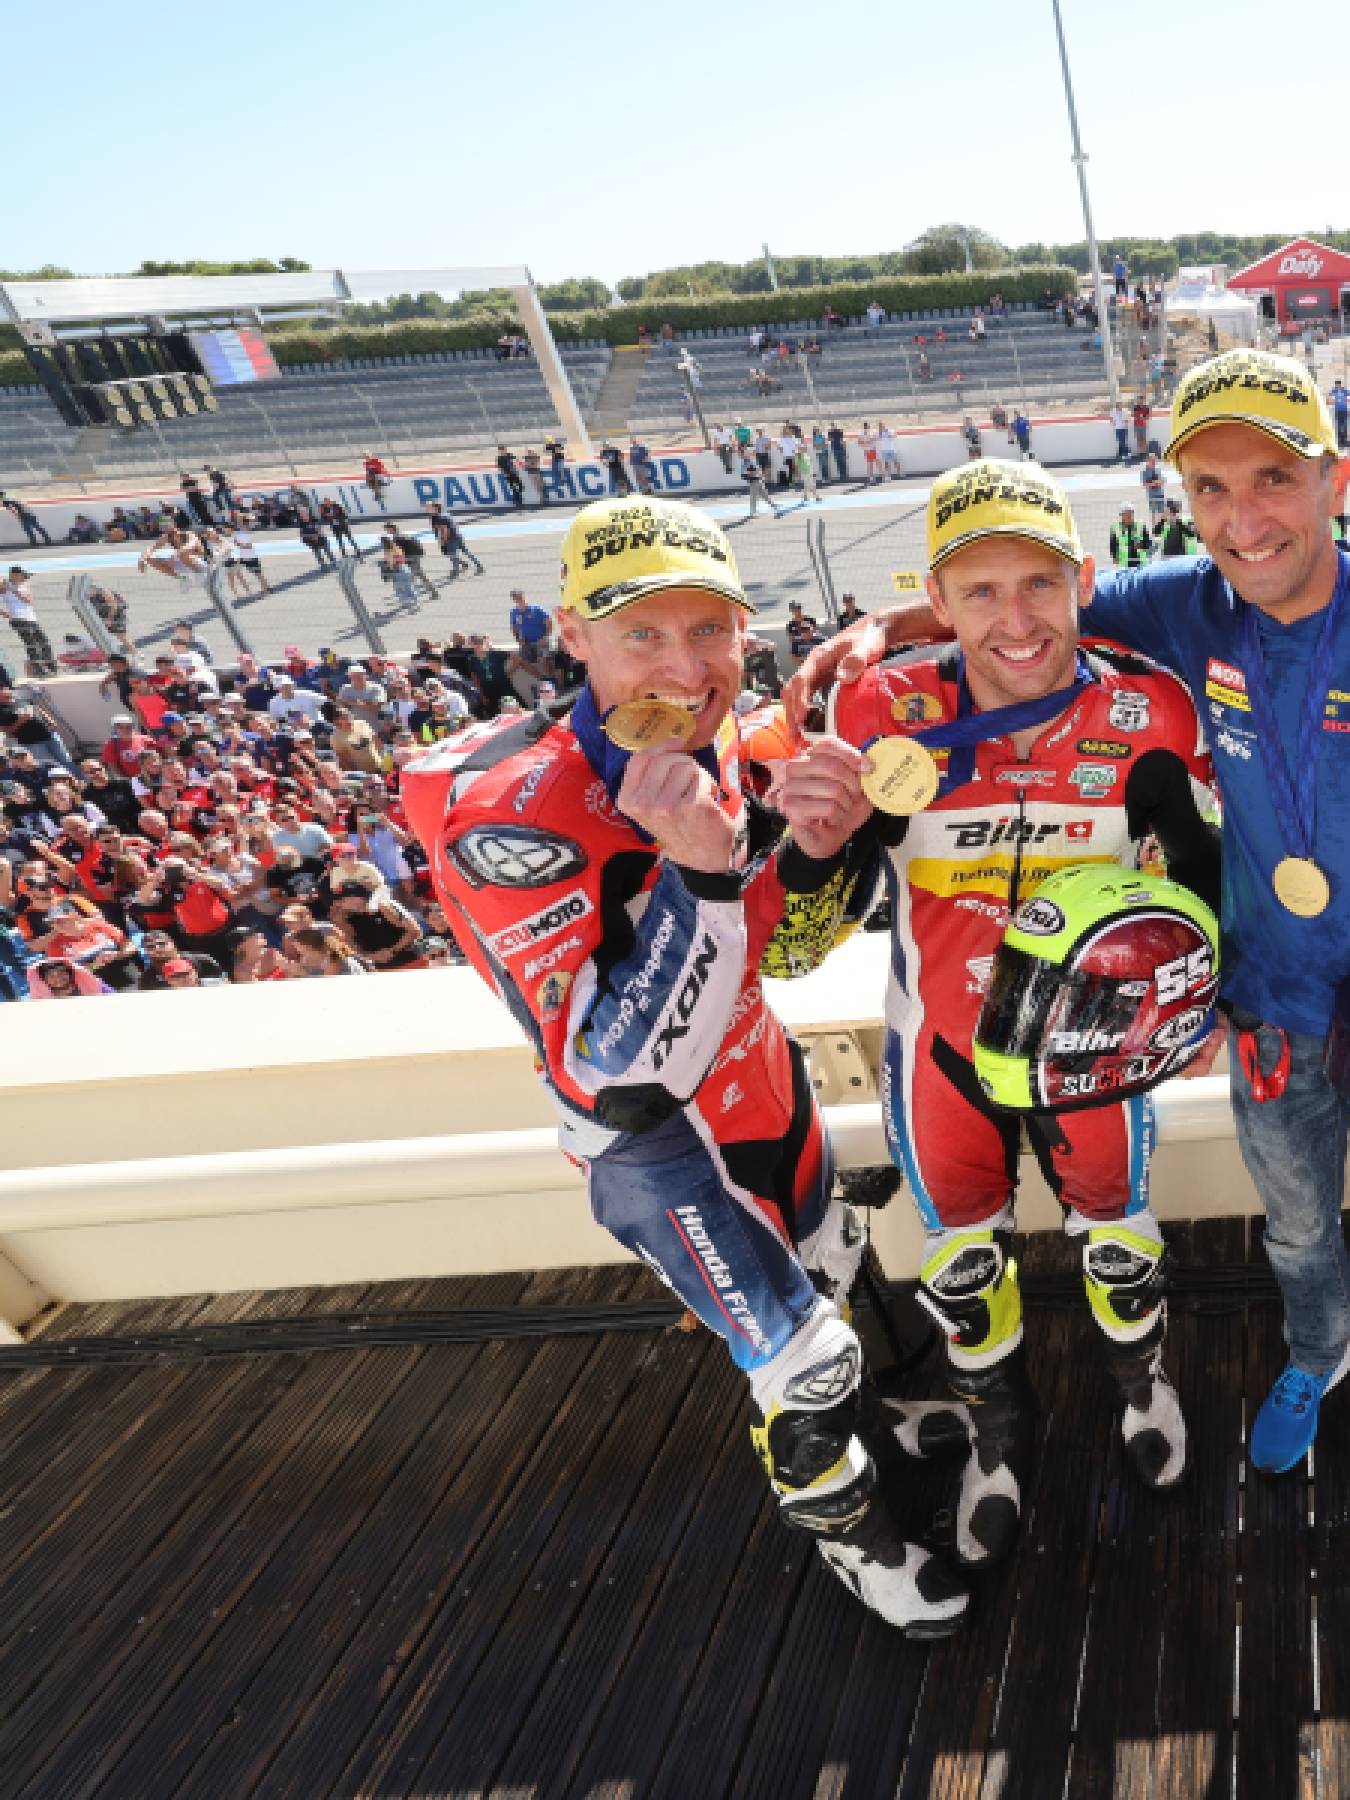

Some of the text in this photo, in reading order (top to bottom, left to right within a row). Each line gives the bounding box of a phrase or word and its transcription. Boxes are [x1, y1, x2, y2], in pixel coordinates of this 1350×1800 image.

[1279, 254, 1324, 280] Dafy
[1178, 373, 1309, 418] DUNLOP
[540, 458, 691, 499] RICD
[935, 484, 1063, 529] DUNLOP
[582, 530, 728, 570] DUNLOP
[945, 816, 1061, 849] Bihr
[1154, 944, 1211, 1007] 55
[650, 932, 718, 1072] IXON
[1049, 1030, 1126, 1053] Bihr
[675, 1204, 734, 1288] Honda
